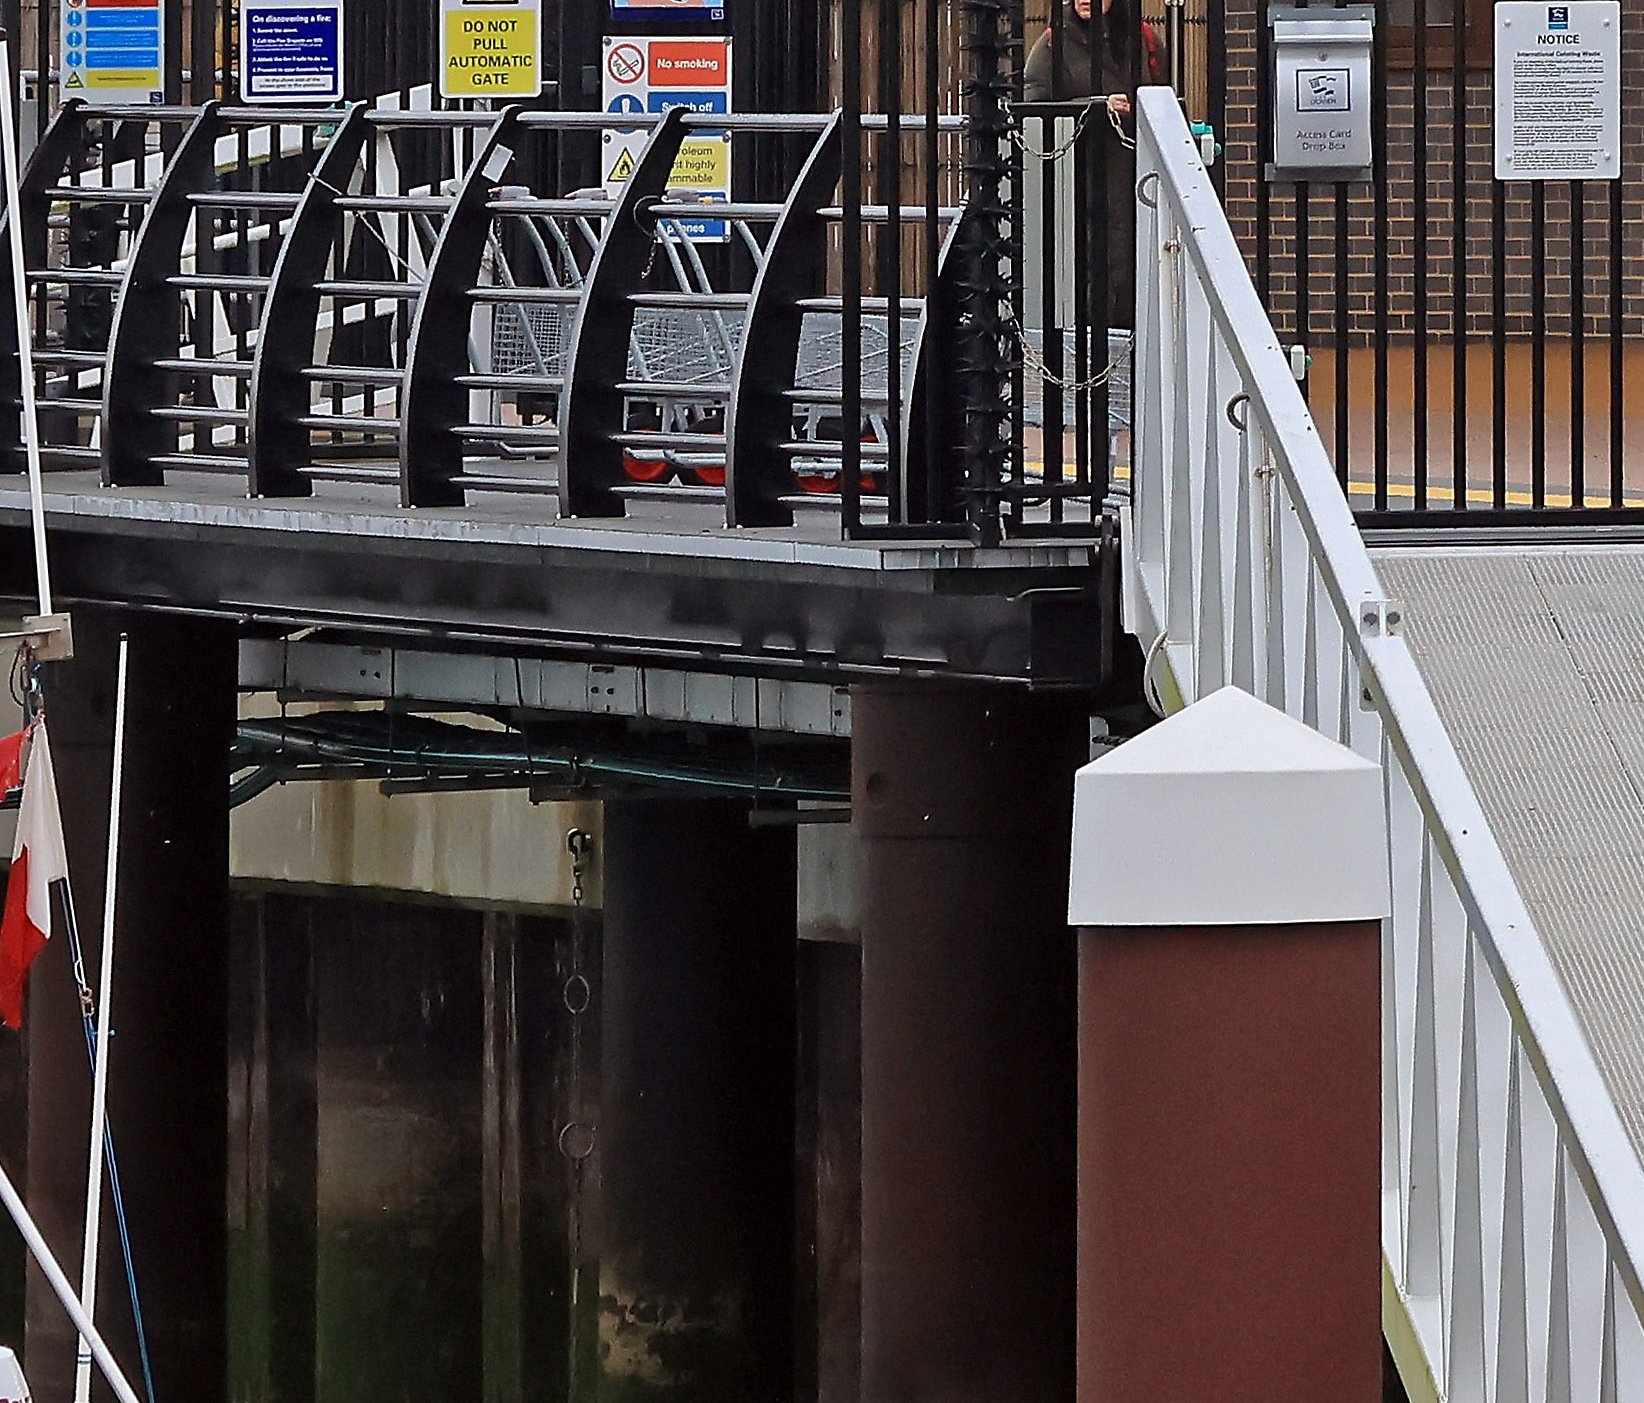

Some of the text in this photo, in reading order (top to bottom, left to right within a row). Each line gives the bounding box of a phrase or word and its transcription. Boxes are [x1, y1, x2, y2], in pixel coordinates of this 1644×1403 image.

[463, 21, 517, 32] DO NOT
[473, 38, 507, 50] PULL
[1537, 34, 1580, 44] NOTICE
[448, 55, 532, 68] AUTOMATIC
[657, 58, 718, 72] No smoking
[472, 73, 509, 85] GATE
[698, 101, 714, 112] off
[1329, 129, 1352, 139] Card
[680, 146, 713, 156] oleum
[685, 160, 716, 171] highly
[666, 225, 705, 235] pones
